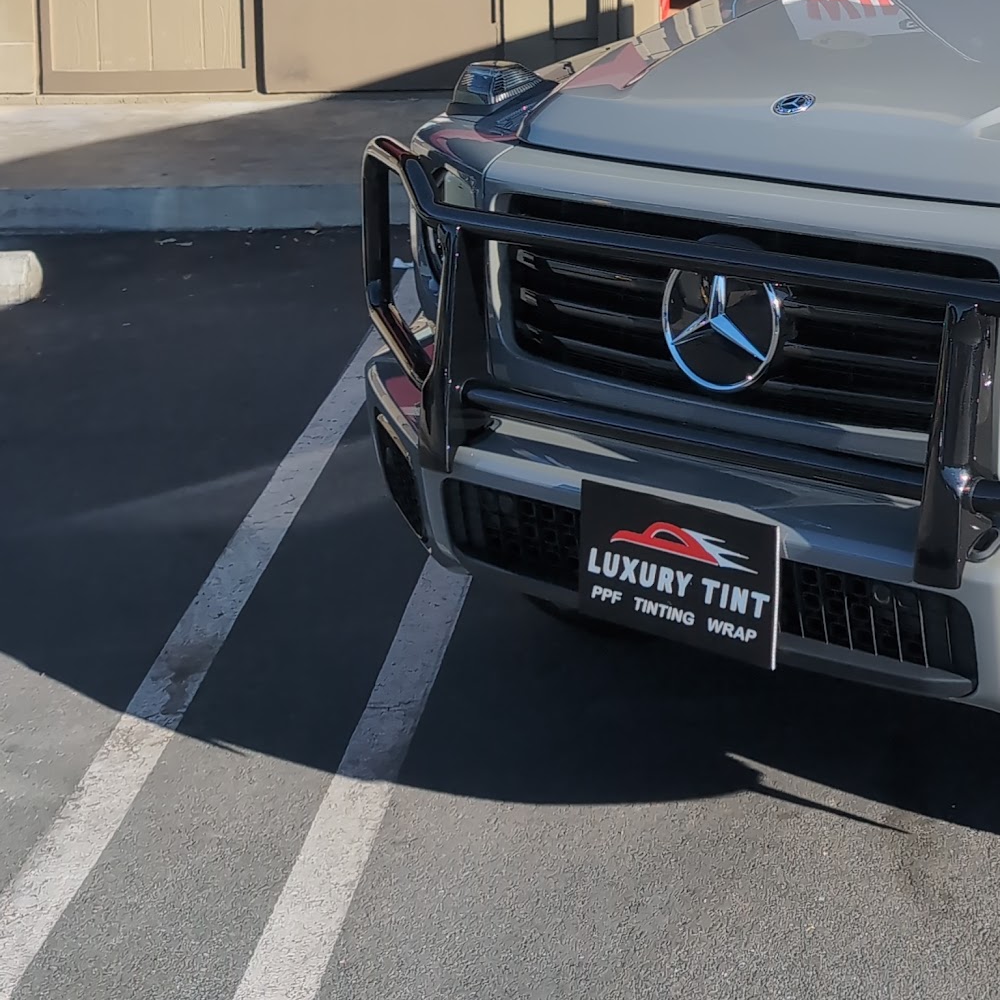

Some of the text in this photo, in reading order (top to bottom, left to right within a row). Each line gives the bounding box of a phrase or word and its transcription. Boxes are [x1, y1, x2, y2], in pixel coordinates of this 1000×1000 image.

[587, 547, 771, 619] LUXURY TINT
[591, 585, 757, 643] PPF TINTING WRAP
